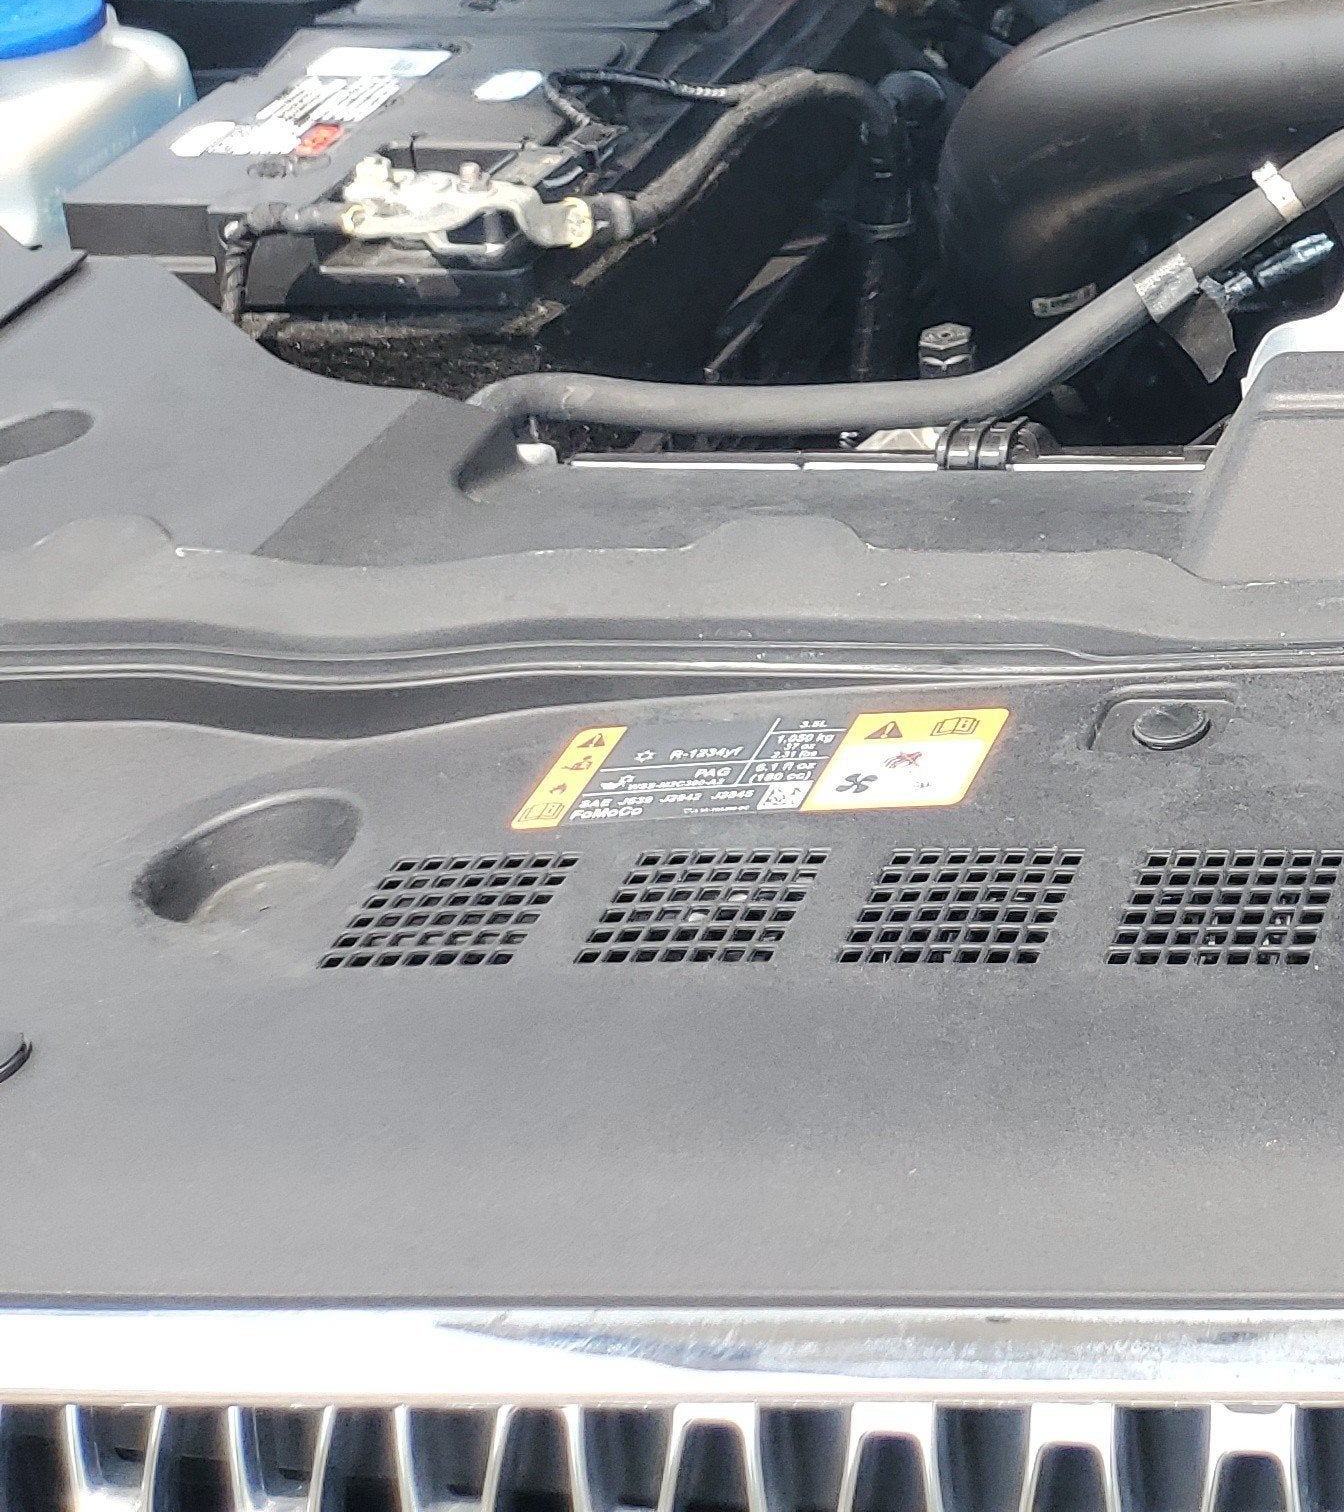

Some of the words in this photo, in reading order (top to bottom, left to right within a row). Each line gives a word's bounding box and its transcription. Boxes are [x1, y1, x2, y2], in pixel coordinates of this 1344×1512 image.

[816, 733, 835, 743] kg
[670, 746, 744, 761] R-1234yf
[796, 762, 817, 770] oz
[694, 767, 732, 778] PAG
[579, 798, 613, 808] SAE
[569, 806, 643, 820] FoMoCo
